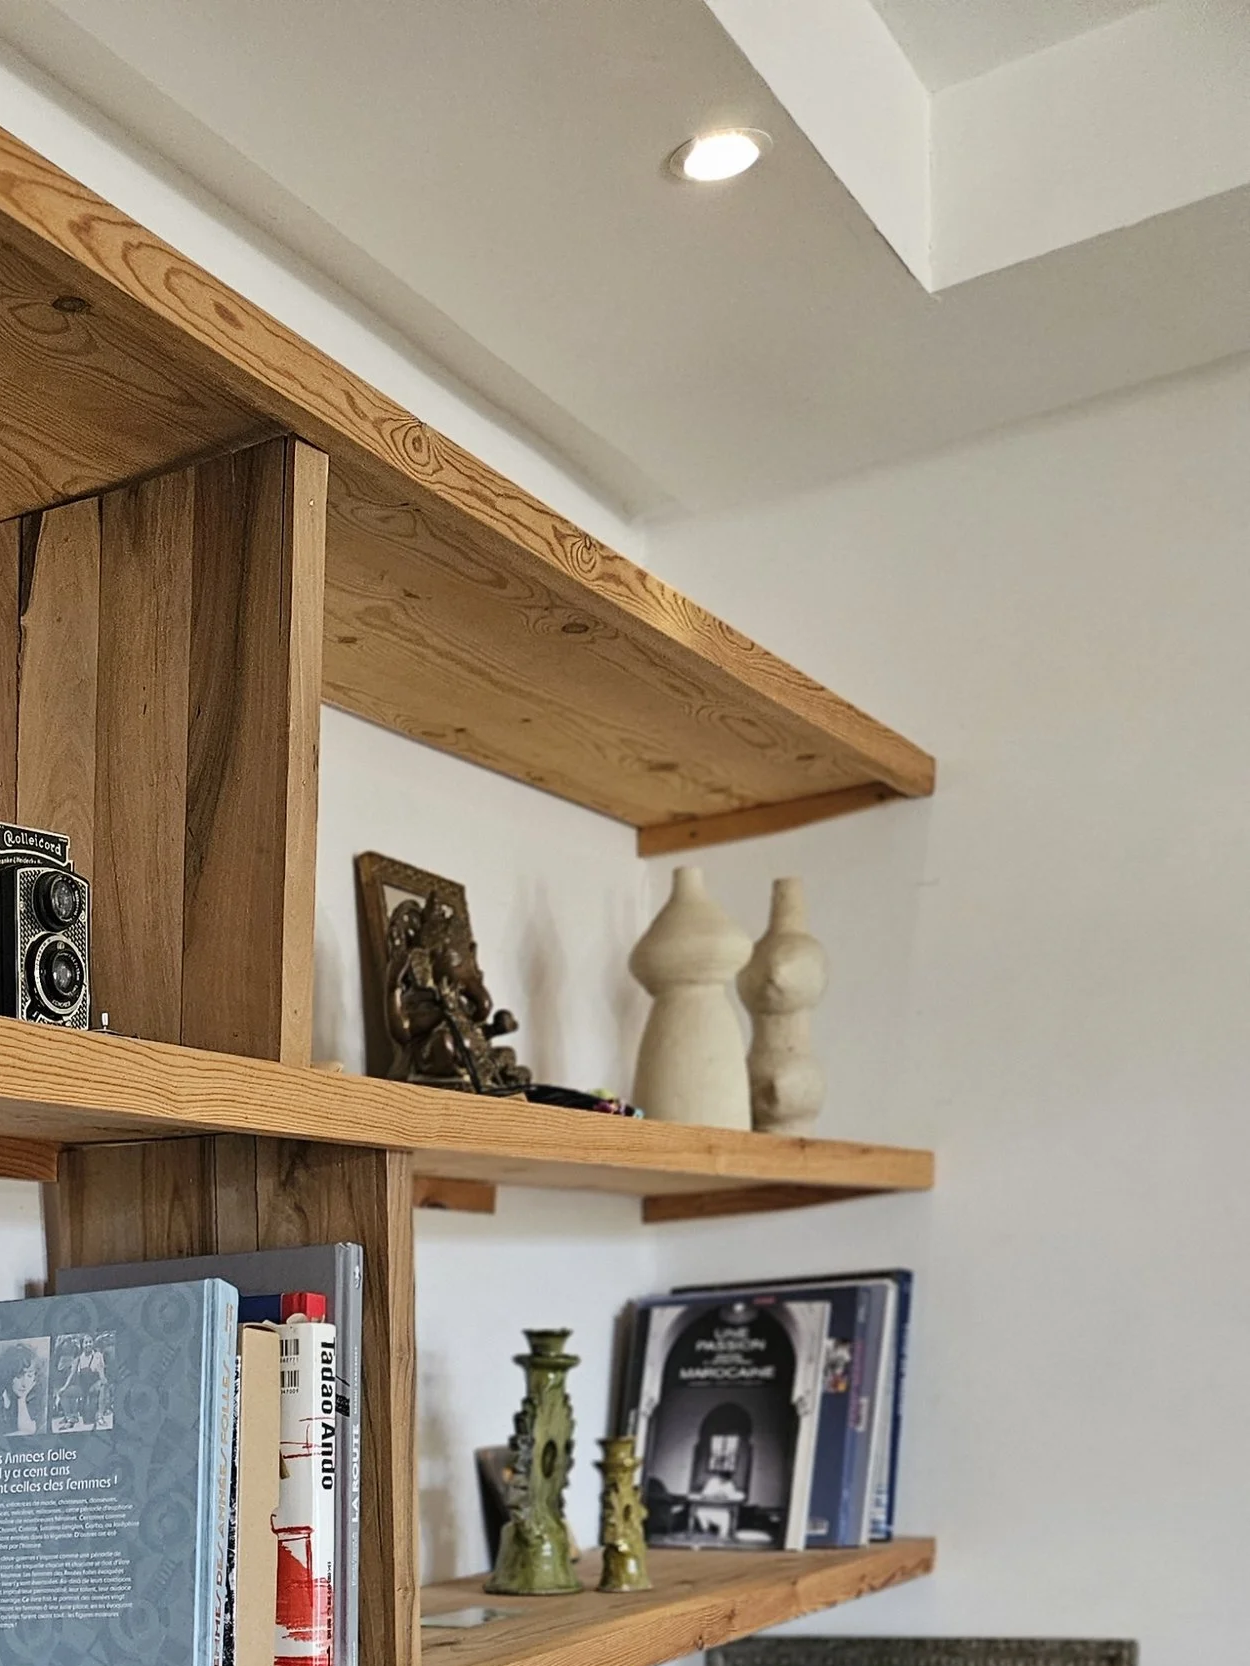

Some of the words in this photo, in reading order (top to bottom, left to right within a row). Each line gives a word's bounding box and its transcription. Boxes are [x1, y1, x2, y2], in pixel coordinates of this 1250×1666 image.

[3, 829, 62, 857] Rolleicord
[321, 1337, 336, 1415] Tadao
[678, 1365, 777, 1380] MAROCAINE
[221, 1360, 230, 1444] FOLLES
[48, 1448, 77, 1461] folles
[321, 1423, 336, 1490] Ando
[352, 1424, 361, 1493] ROUTE
[4, 1470, 11, 1482] y
[13, 1469, 21, 1478] a
[23, 1467, 48, 1478] cent
[50, 1465, 70, 1476] ans
[10, 1481, 41, 1493] celles
[43, 1479, 64, 1492] des
[66, 1477, 111, 1490] femmes
[351, 1497, 359, 1523] LA
